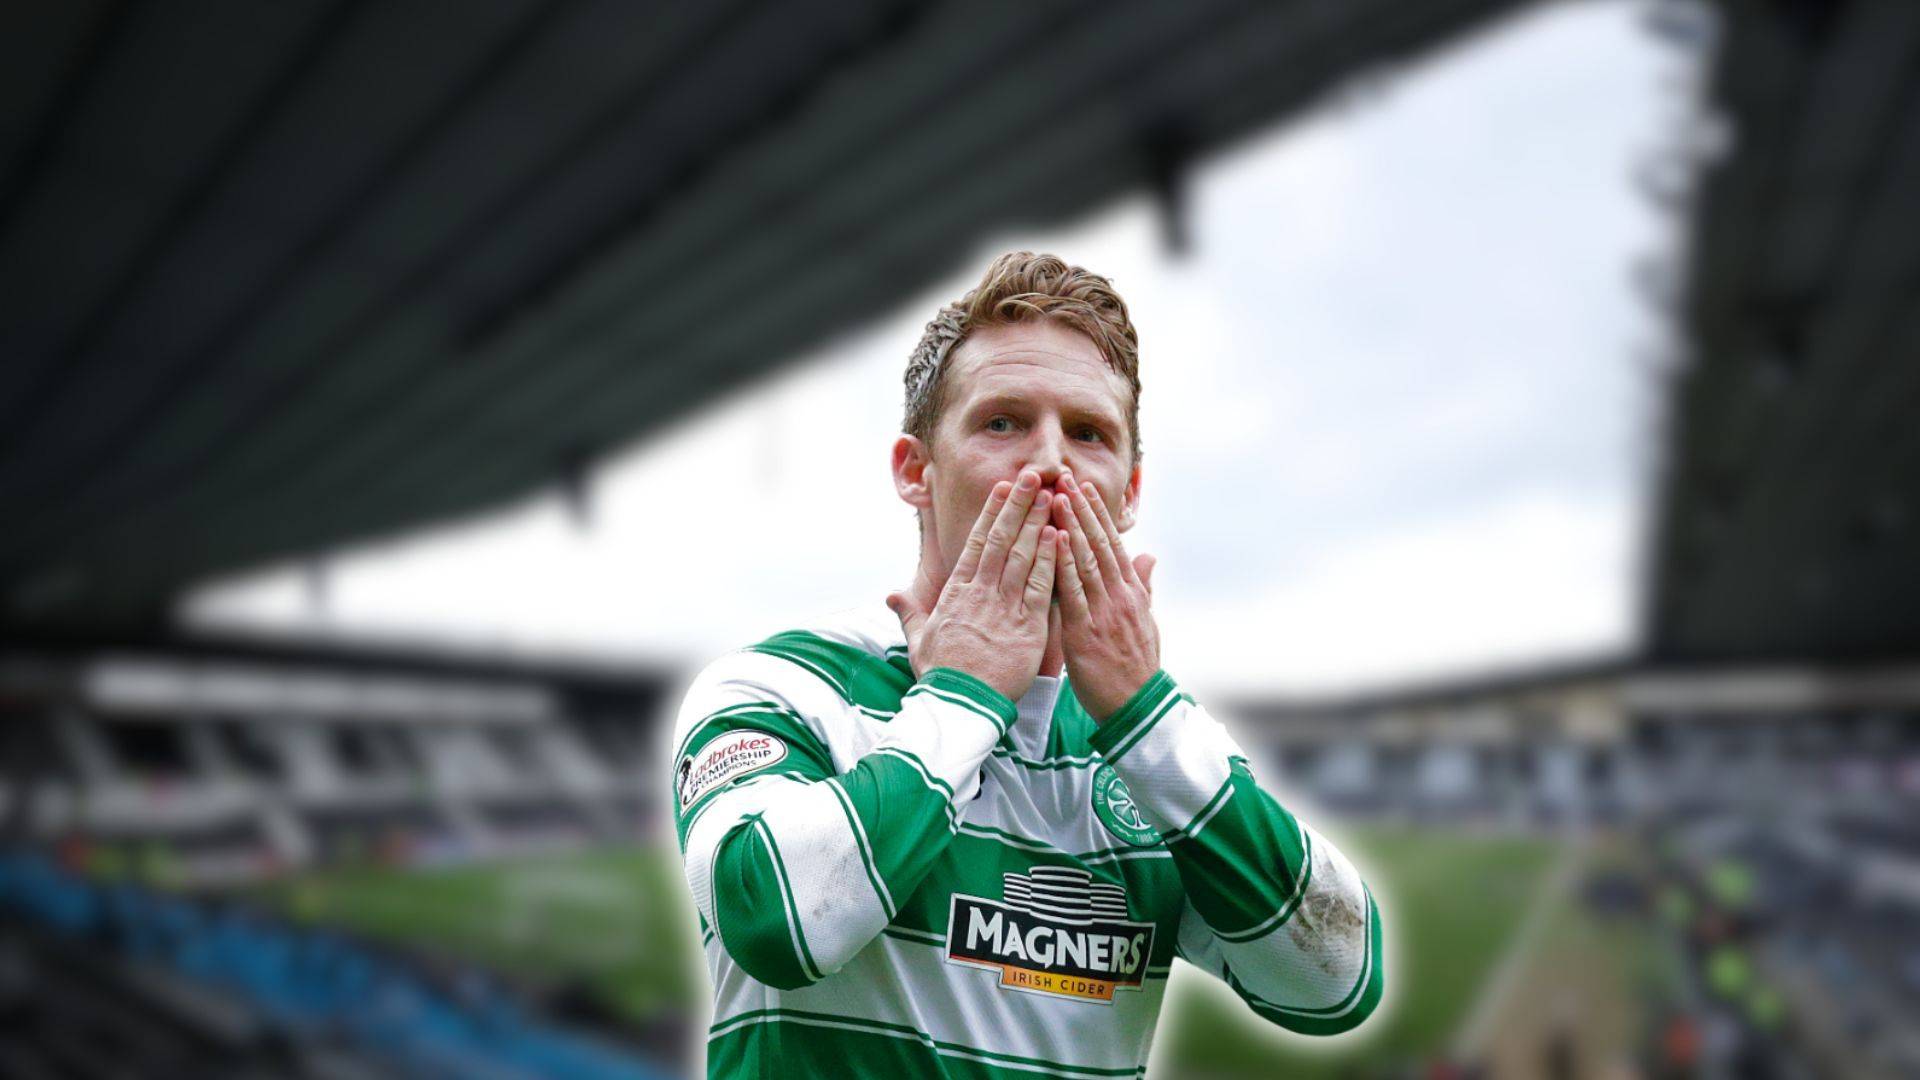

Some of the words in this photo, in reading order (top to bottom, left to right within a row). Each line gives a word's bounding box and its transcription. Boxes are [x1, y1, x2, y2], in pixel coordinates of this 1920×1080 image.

[690, 752, 772, 792] PREMIERSHIP
[702, 760, 757, 788] CHAMPIONS
[966, 906, 1144, 974] MAGNERS
[1012, 970, 1053, 988] IRISH
[1060, 979, 1106, 995] CIDER
